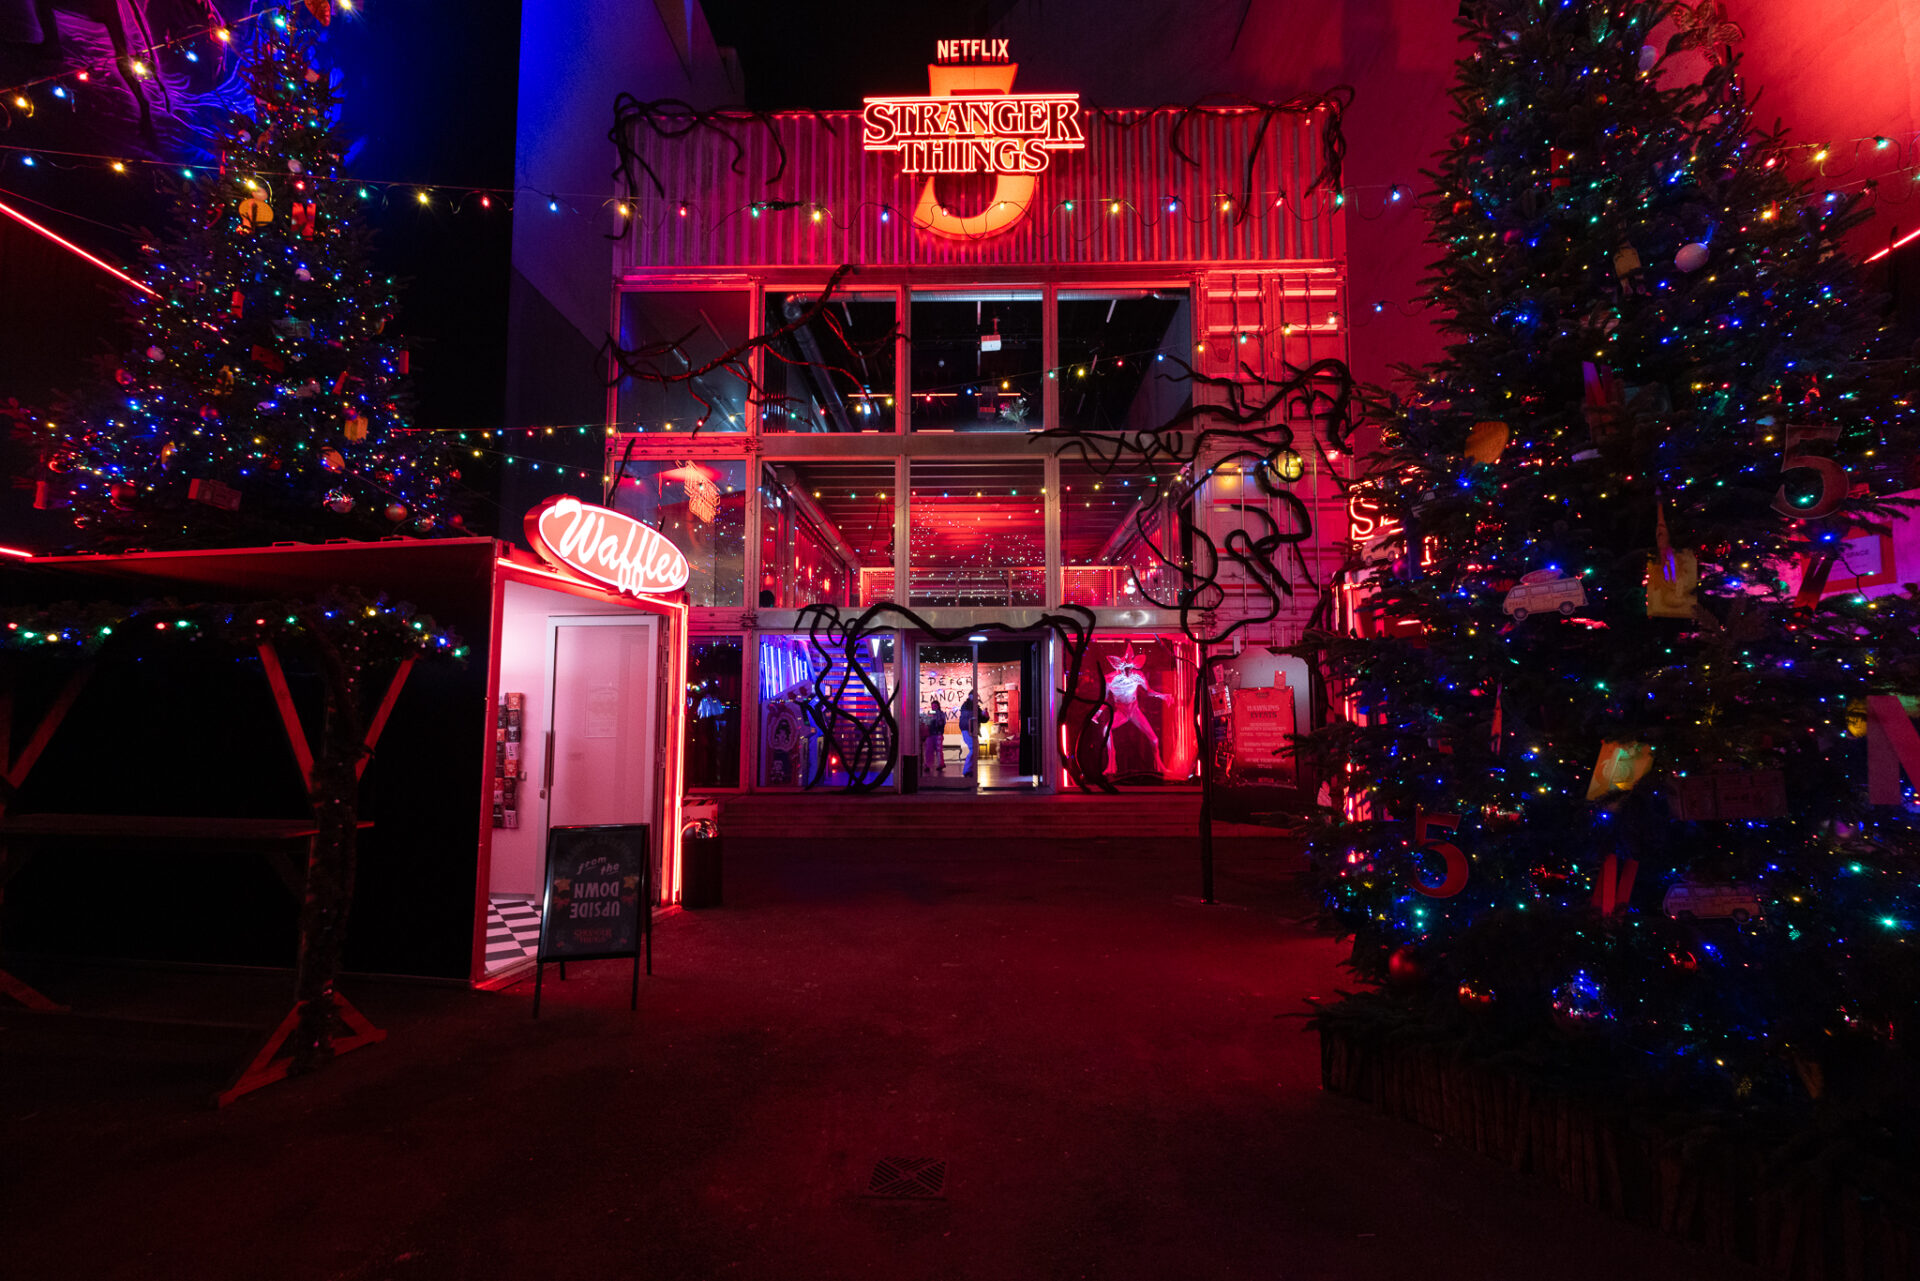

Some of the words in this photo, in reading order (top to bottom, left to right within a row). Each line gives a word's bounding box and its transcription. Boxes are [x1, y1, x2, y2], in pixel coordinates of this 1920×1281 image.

[937, 39, 1009, 61] NETFLIX
[863, 99, 1085, 144] STRANGER
[897, 137, 1050, 173] THINGS
[1769, 423, 1850, 520] 5
[554, 498, 684, 596] Waffles
[576, 856, 607, 875] from
[600, 863, 620, 876] the
[1408, 803, 1470, 899] 5
[574, 880, 620, 899] DOWN
[569, 900, 621, 919] UPSIDE
